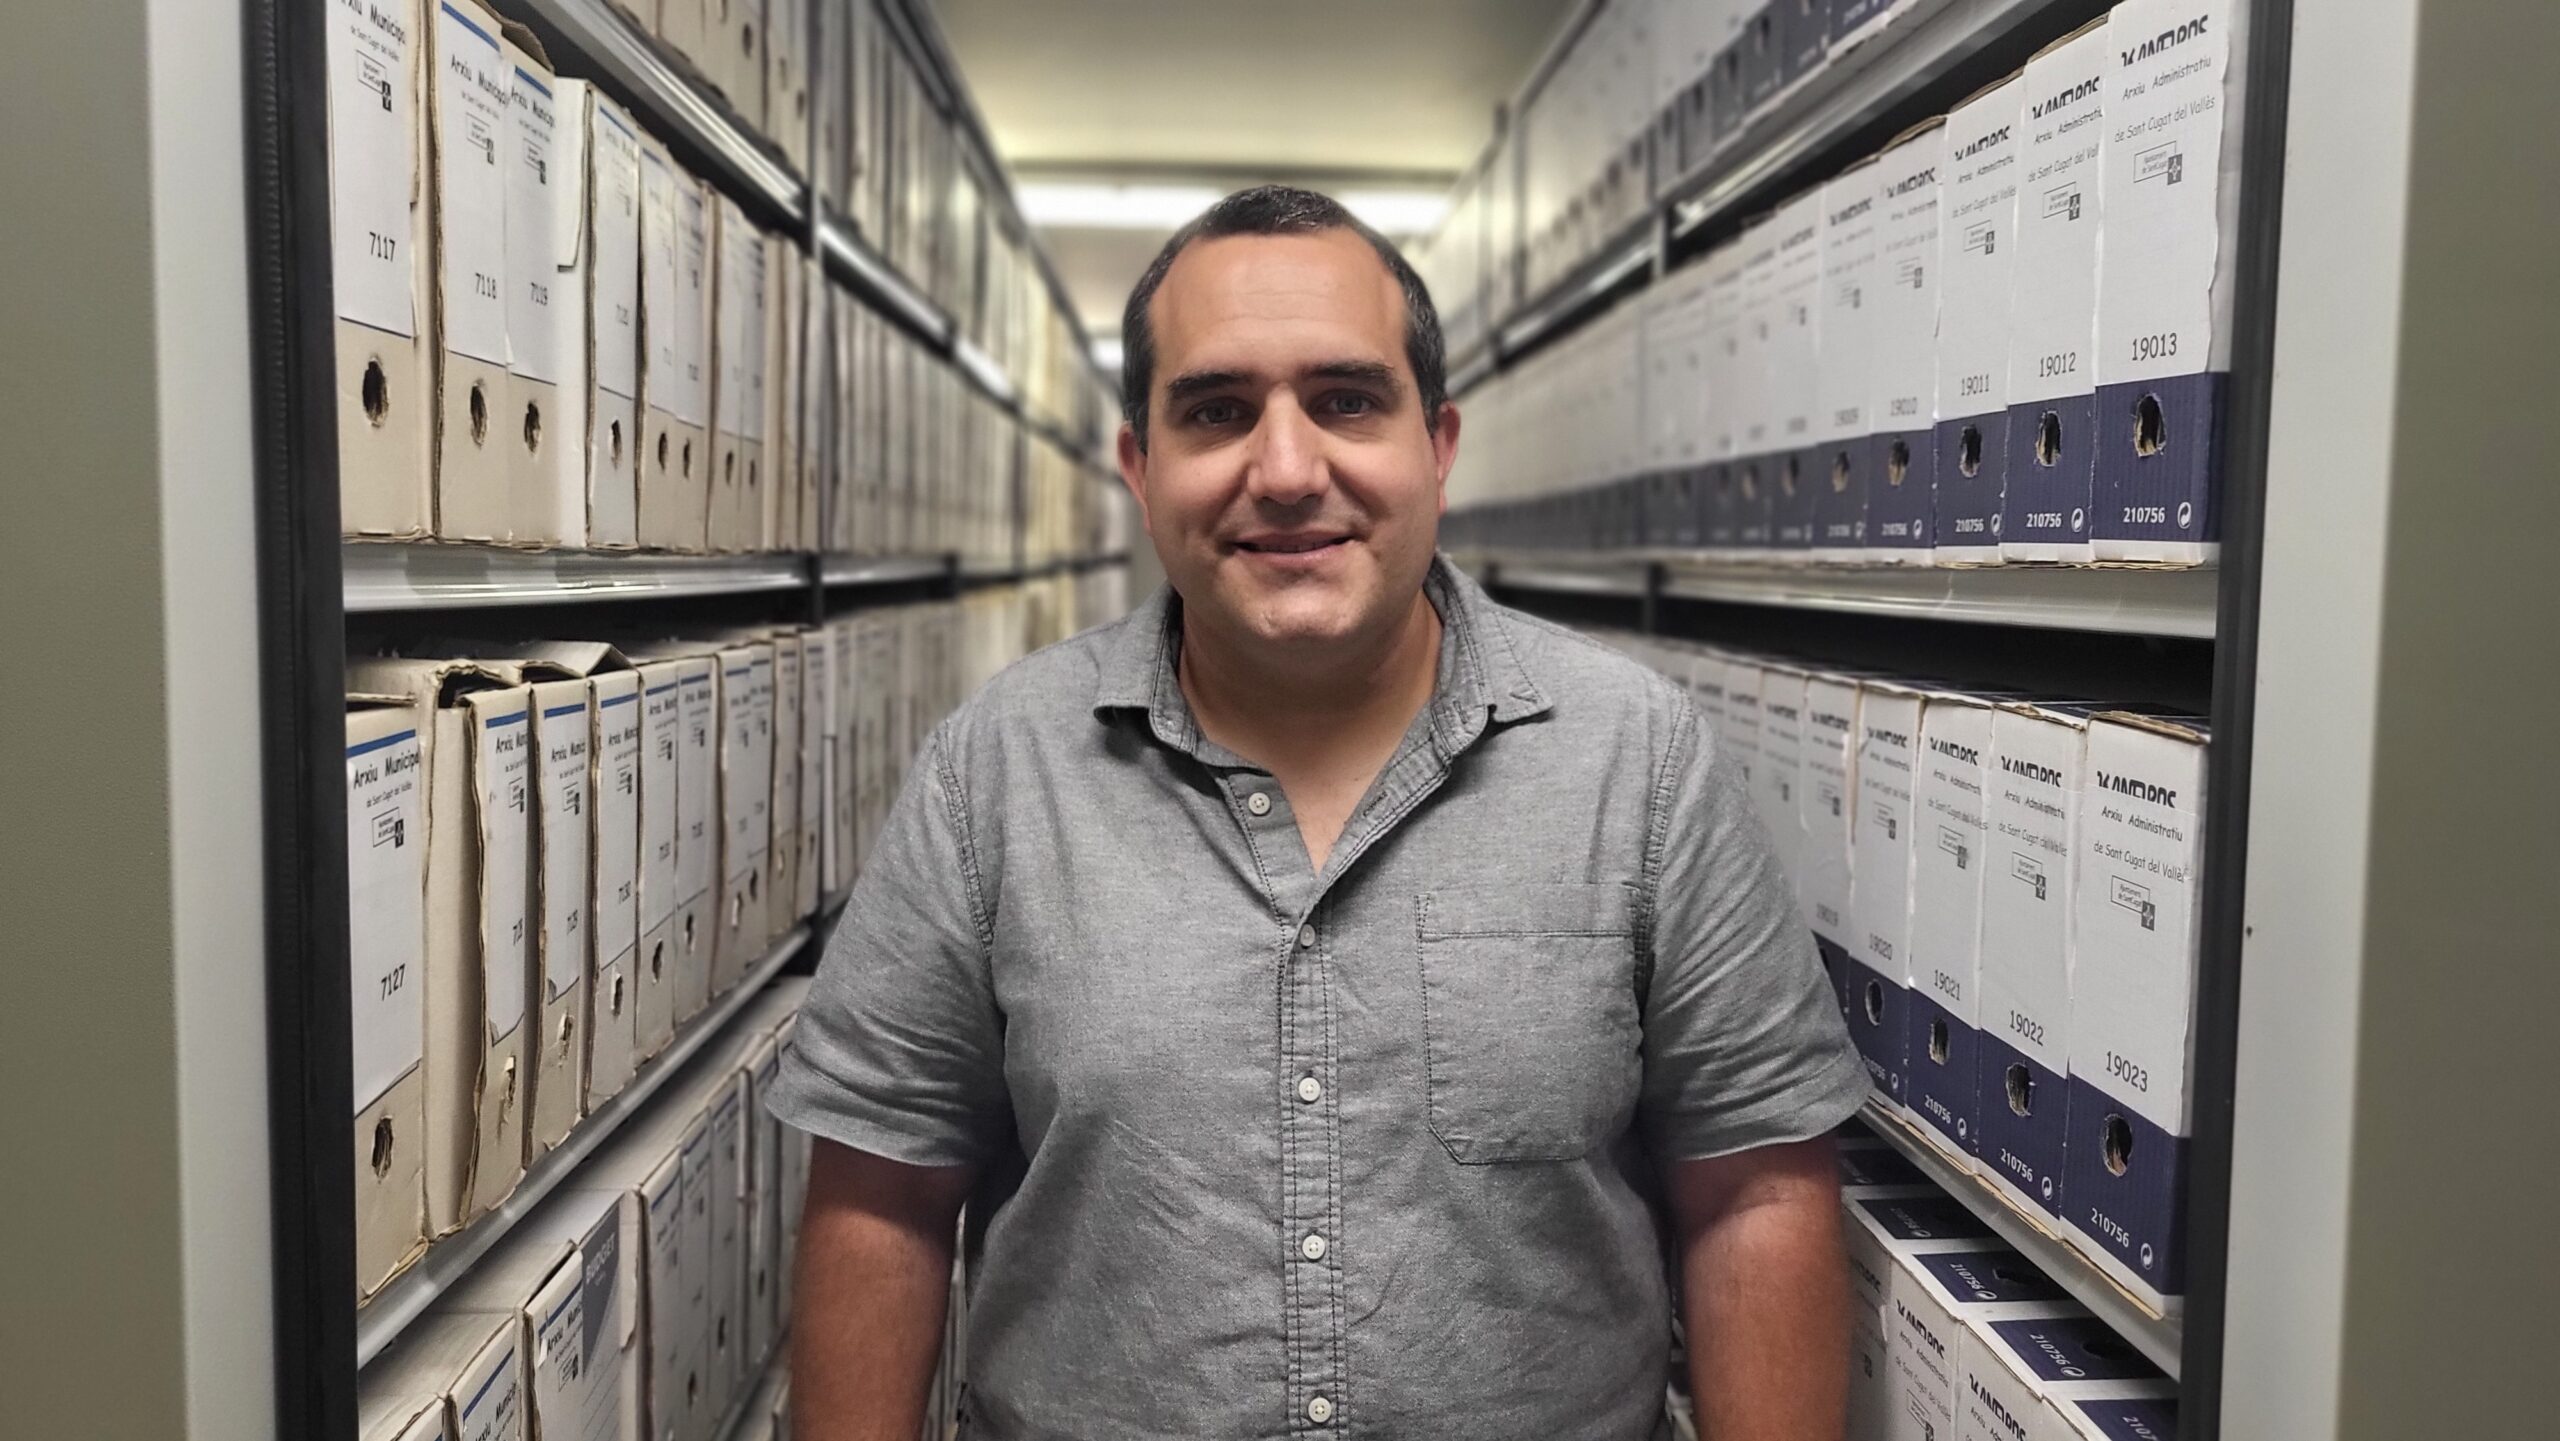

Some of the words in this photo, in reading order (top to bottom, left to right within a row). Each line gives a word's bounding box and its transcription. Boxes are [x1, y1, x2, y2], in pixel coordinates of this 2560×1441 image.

[2123, 82, 2146, 101] Arxiu
[2152, 55, 2212, 90] Administratiu
[2034, 130, 2053, 145] Arxiu
[2115, 129, 2125, 143] de
[2127, 122, 2146, 139] Sant
[2148, 111, 2172, 132] Cugat
[2174, 103, 2188, 121] del
[369, 231, 396, 262] 7117
[475, 272, 497, 300] 7118
[2132, 332, 2178, 361] 19013
[2039, 352, 2076, 378] 19012
[1960, 374, 1989, 396] 19011
[1955, 518, 1984, 533] 210756
[2026, 513, 2062, 528] 210756
[2123, 507, 2165, 523] 210756
[354, 763, 378, 790] Arxiu
[2102, 805, 2122, 823] Arxiu
[2128, 814, 2183, 842] Administratiu
[2094, 841, 2103, 854] de
[2105, 844, 2122, 861] Sant
[2124, 850, 2146, 870] Cugat
[2148, 859, 2160, 874] del
[381, 963, 405, 1001] 7127
[1934, 969, 1961, 1002] 19021
[2010, 1010, 2044, 1047] 19022
[2106, 1050, 2148, 1093] 19023
[1924, 1094, 1952, 1124] 210756
[2000, 1148, 2033, 1183] 210756
[2091, 1207, 2130, 1249] 210756
[1950, 1263, 1985, 1290] 210756
[2030, 1333, 2071, 1366] 210756
